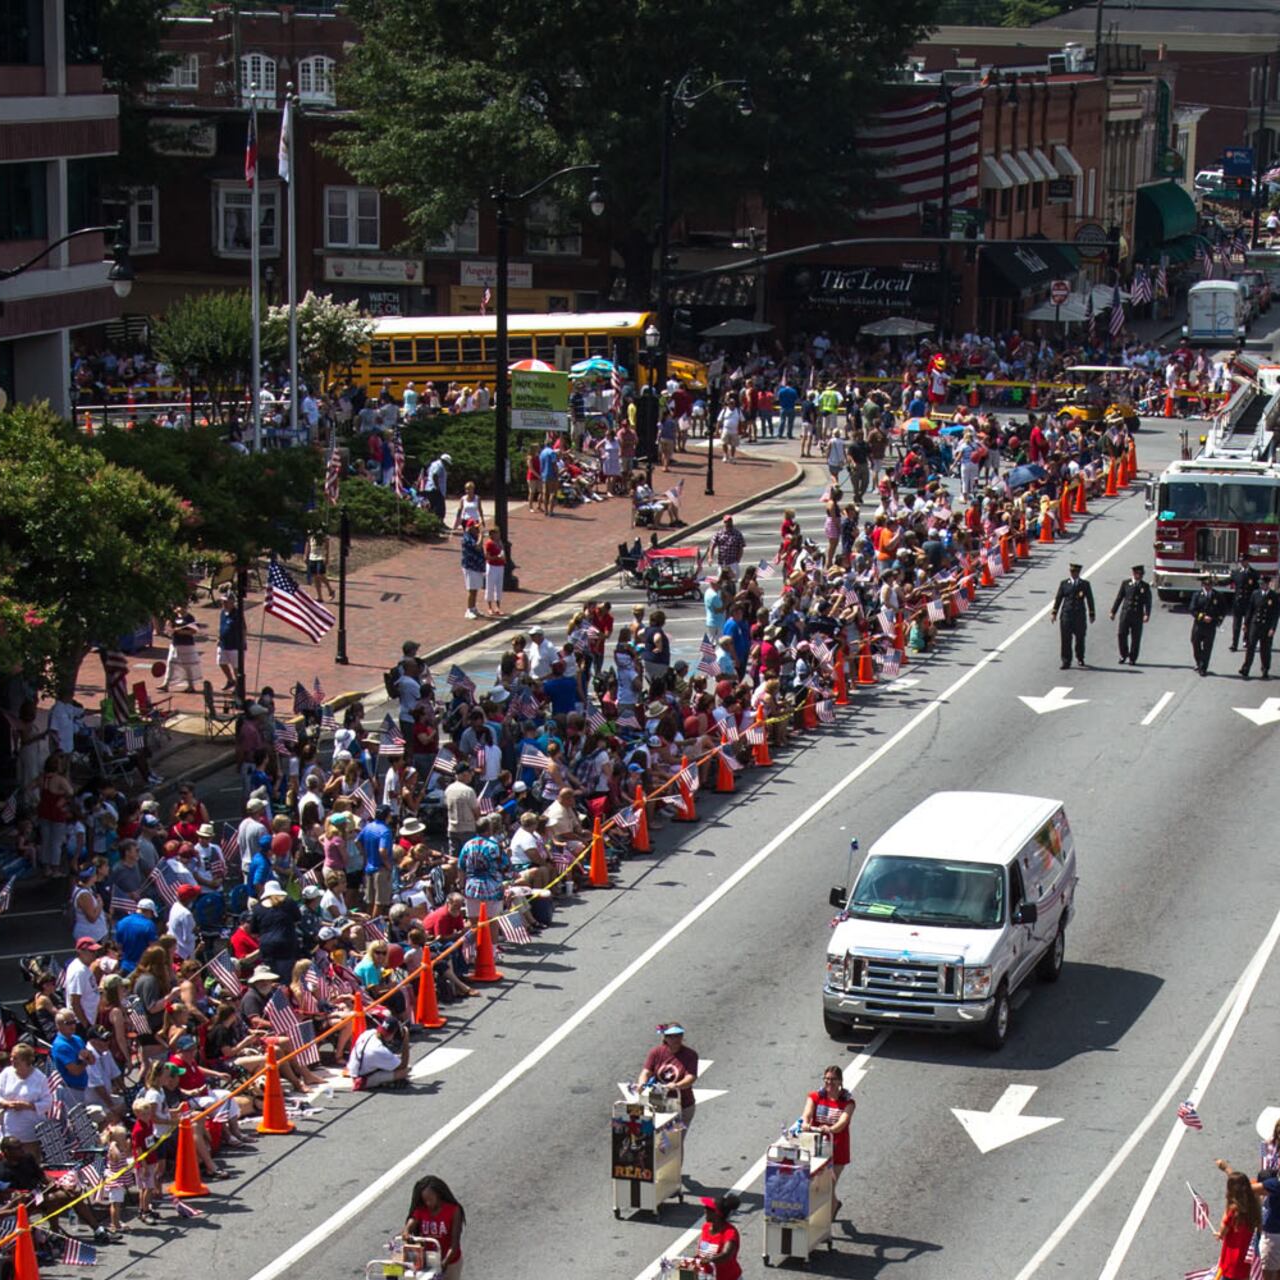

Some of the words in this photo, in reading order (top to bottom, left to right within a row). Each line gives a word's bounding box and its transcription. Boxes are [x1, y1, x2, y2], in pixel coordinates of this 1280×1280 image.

[820, 270, 856, 290] The
[859, 272, 913, 293] Local
[369, 292, 400, 303] WATCH
[614, 1165, 652, 1180] READ
[422, 1220, 448, 1235] USA
